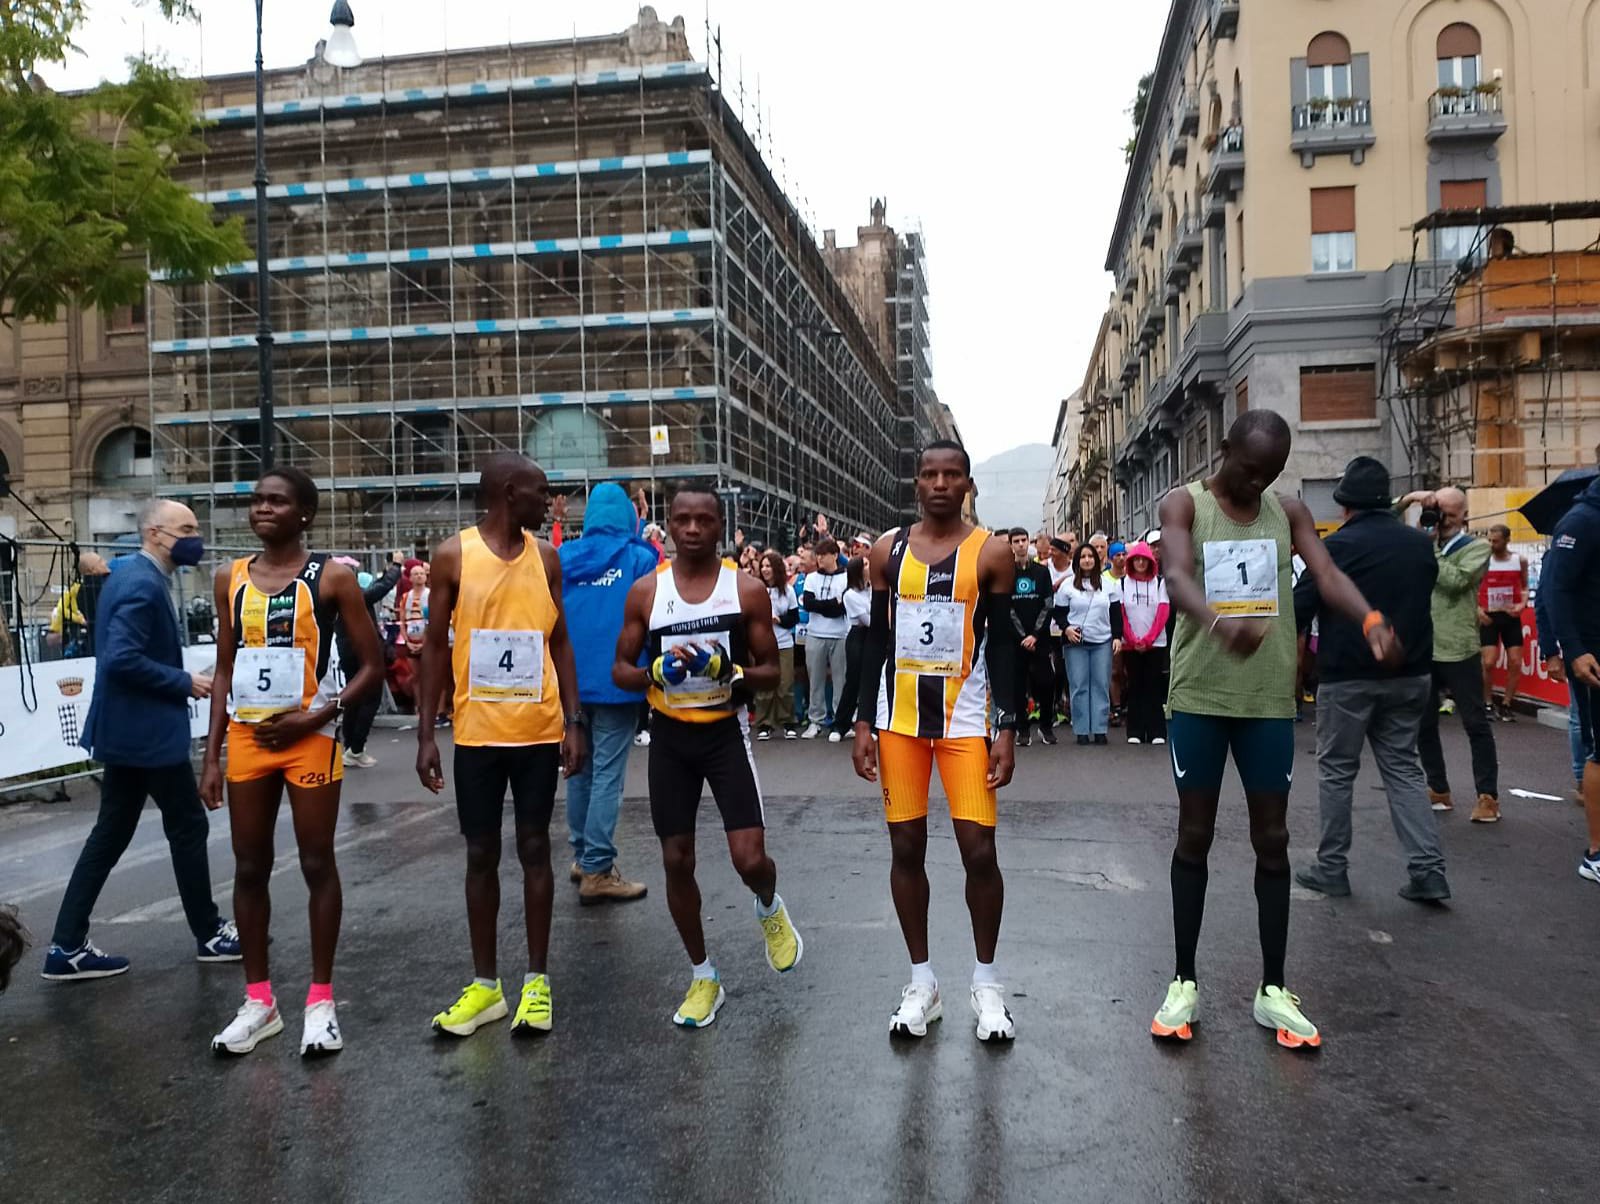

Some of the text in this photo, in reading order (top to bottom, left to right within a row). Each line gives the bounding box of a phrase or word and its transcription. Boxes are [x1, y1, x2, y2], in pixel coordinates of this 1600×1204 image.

[1236, 561, 1249, 586] 1
[919, 621, 935, 646] 3
[498, 649, 515, 673] 4
[256, 668, 273, 693] 5
